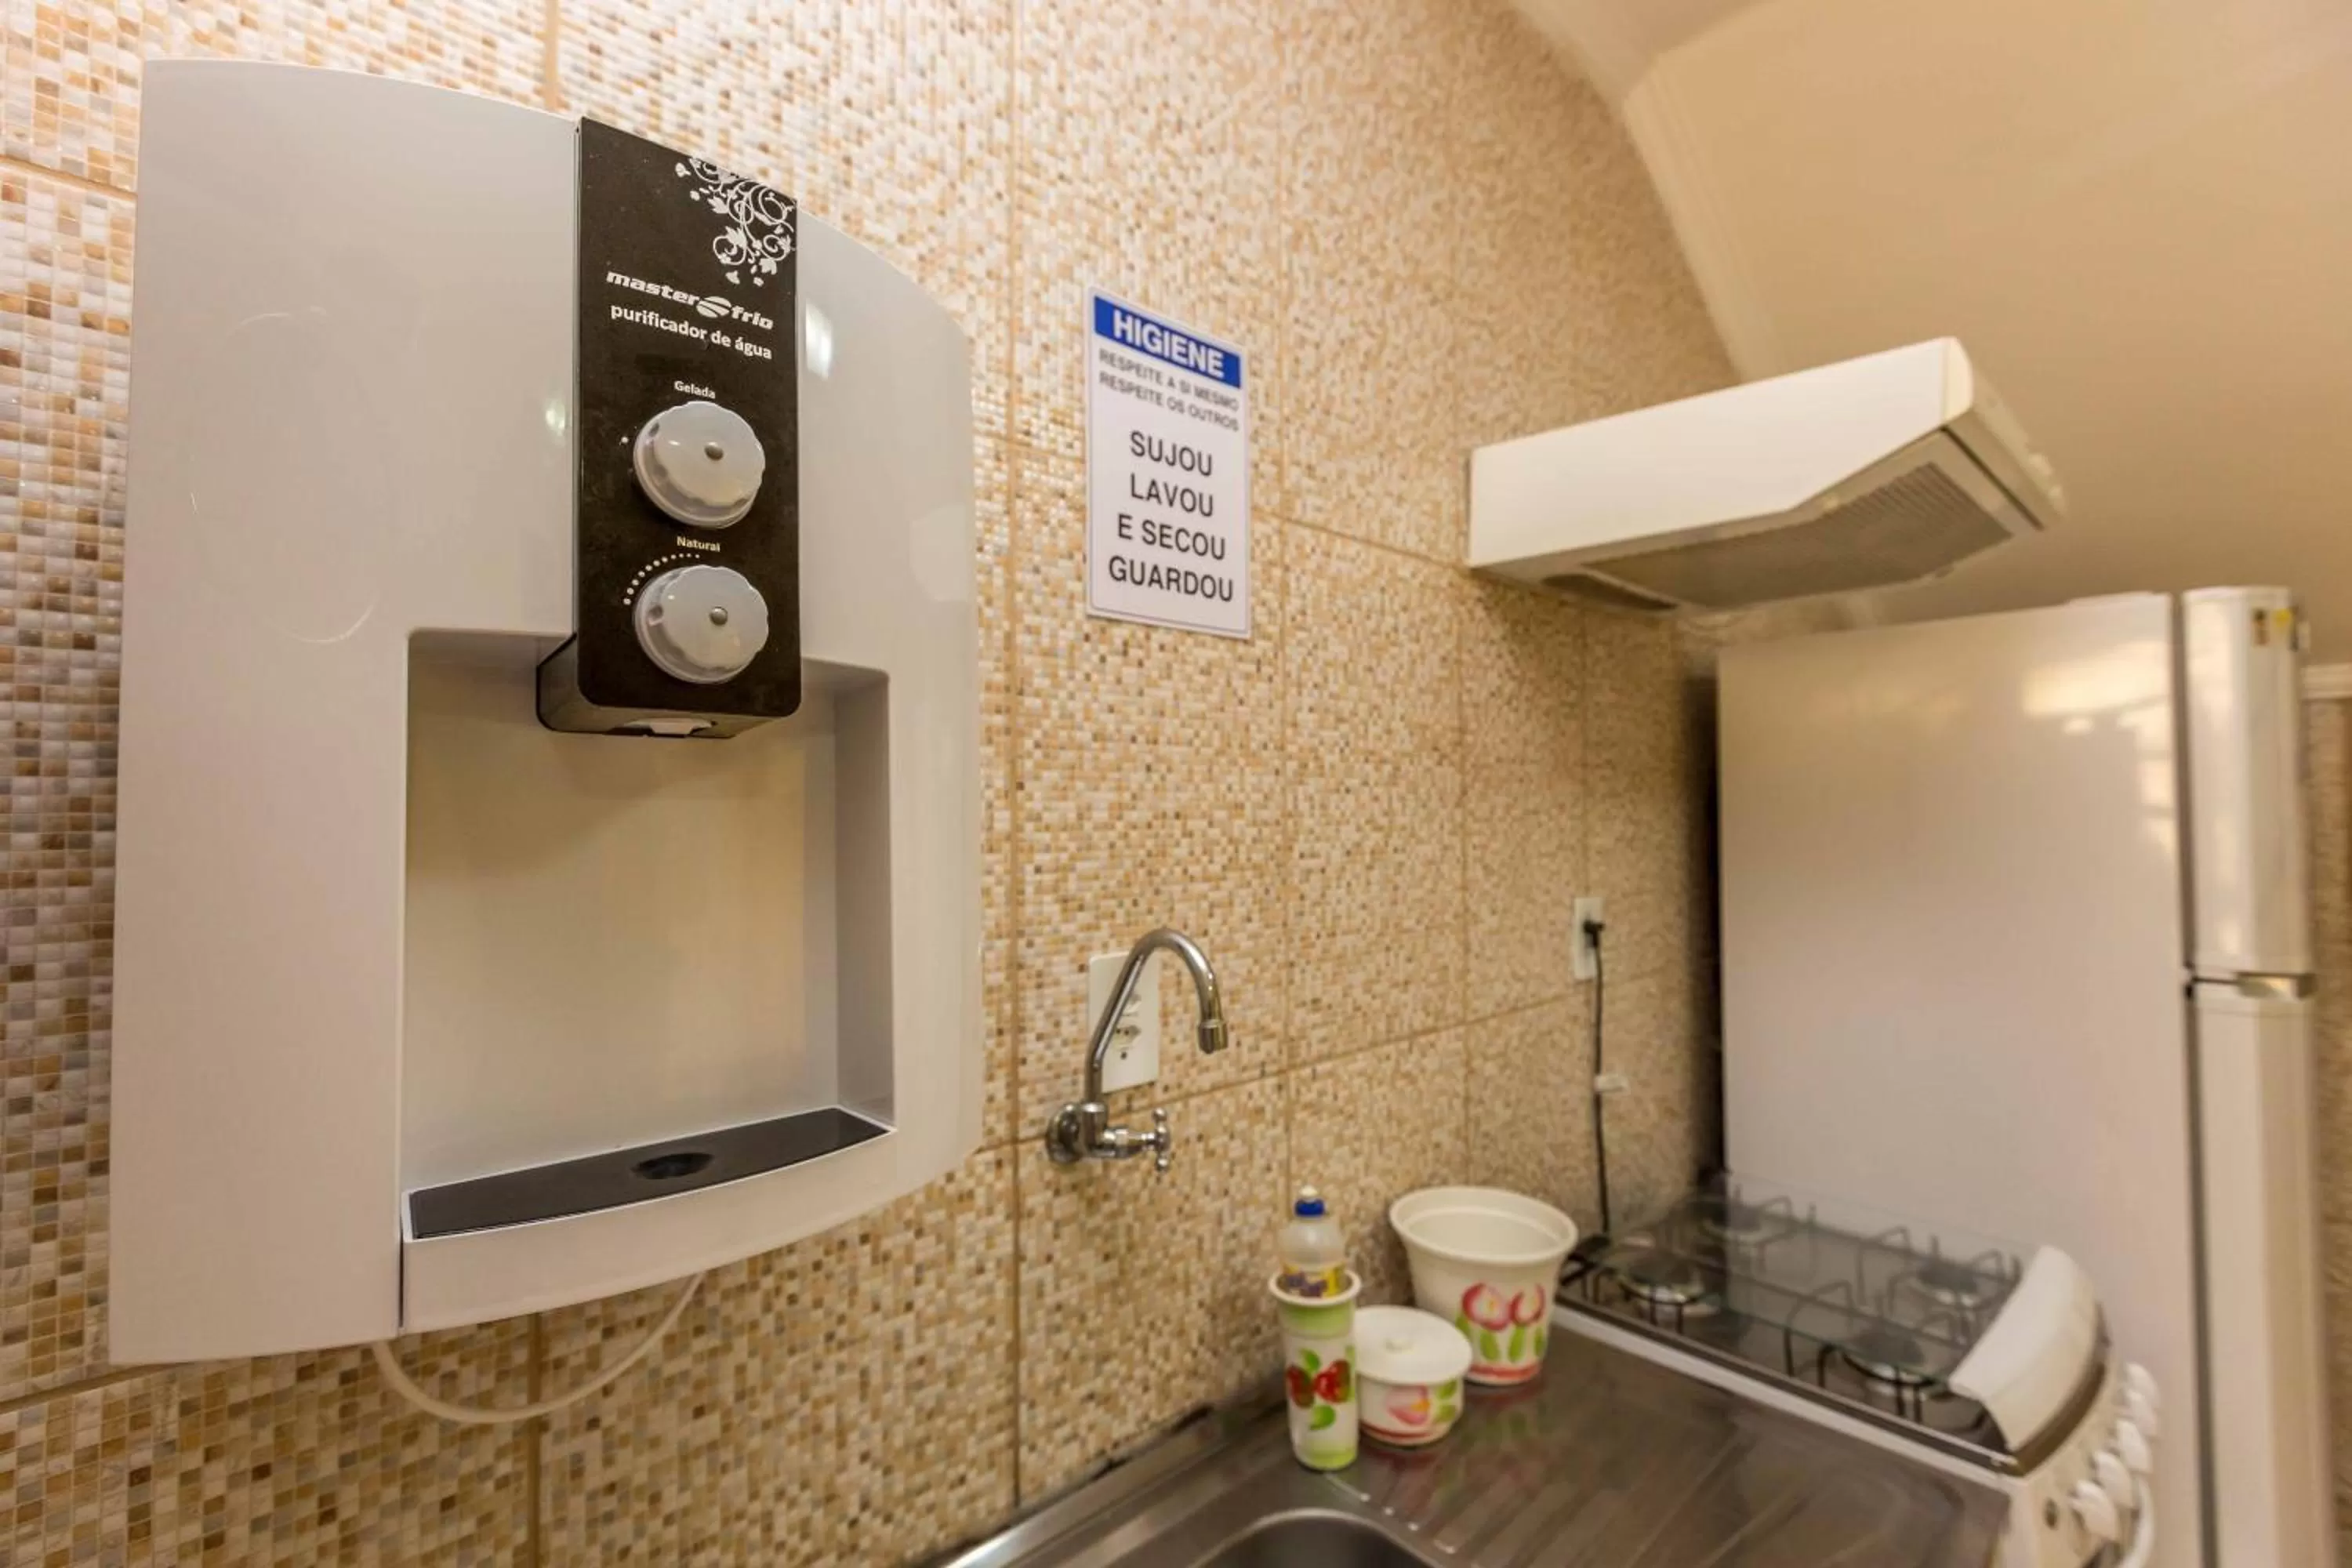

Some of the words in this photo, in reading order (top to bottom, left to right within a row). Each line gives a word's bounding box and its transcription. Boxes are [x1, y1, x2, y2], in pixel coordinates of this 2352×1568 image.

[606, 271, 699, 306] master
[730, 307, 774, 329] frio
[611, 304, 707, 340] purificador
[711, 330, 731, 347] de
[735, 337, 772, 360] água
[1113, 310, 1225, 378] HIGIENE
[674, 380, 715, 399] Gelada
[1099, 348, 1163, 385] RESPEITE
[1167, 376, 1176, 388] A
[1179, 380, 1191, 394] SI
[1193, 385, 1240, 412] MESMO
[1099, 370, 1163, 407] RESPEITE
[1167, 396, 1185, 414] OS
[1188, 405, 1240, 431] OUTROS
[1130, 430, 1213, 477] SUJOU
[1131, 473, 1214, 517] LAVOU
[677, 535, 720, 552] Natural
[1118, 514, 1133, 539] E
[1142, 519, 1225, 561] SECOU
[1109, 555, 1233, 602] GUARDOU
